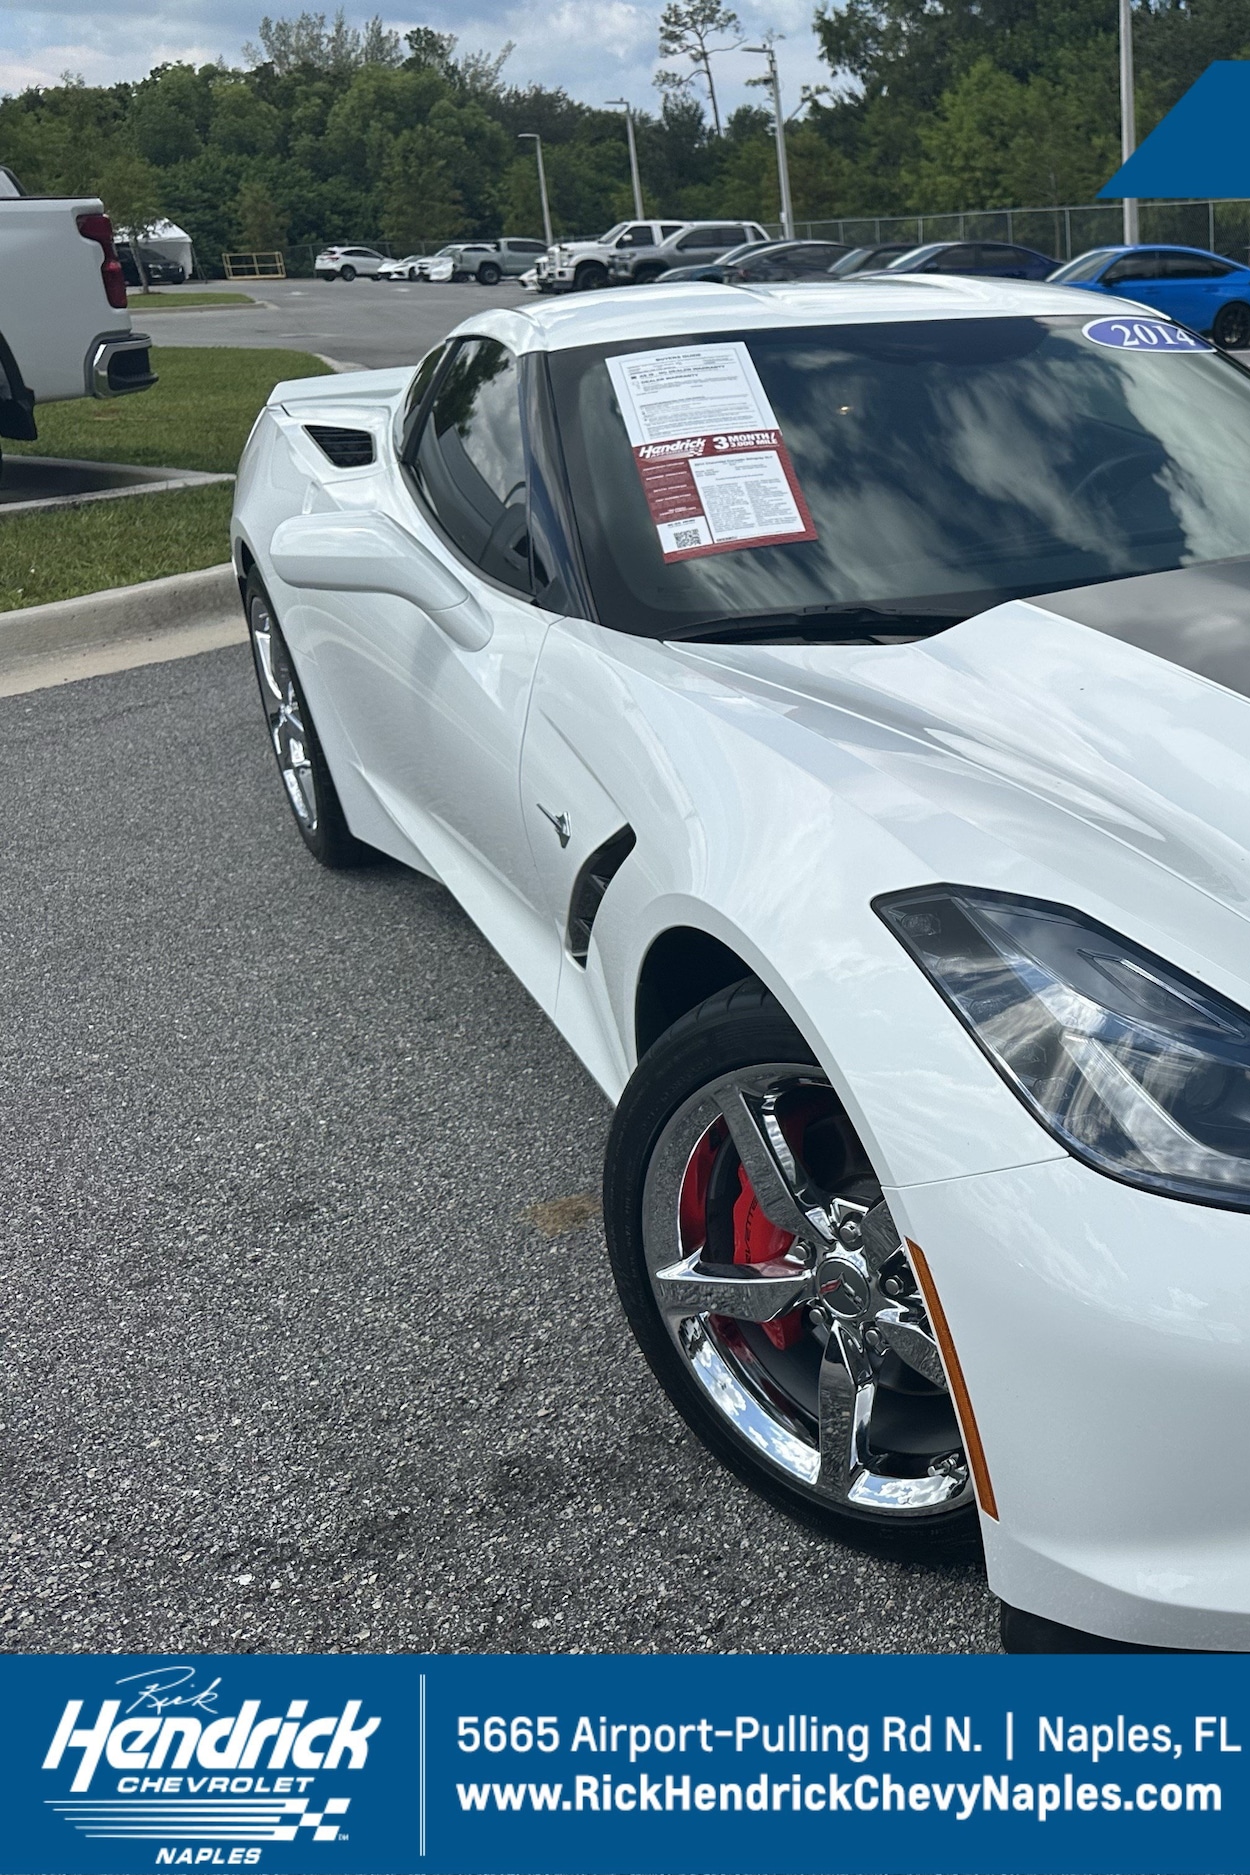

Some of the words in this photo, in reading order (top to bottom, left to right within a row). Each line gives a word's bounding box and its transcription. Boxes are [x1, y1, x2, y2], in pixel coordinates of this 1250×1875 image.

[1110, 323, 1196, 346] 2014
[638, 437, 707, 459] Hendrick
[712, 436, 730, 449] 3
